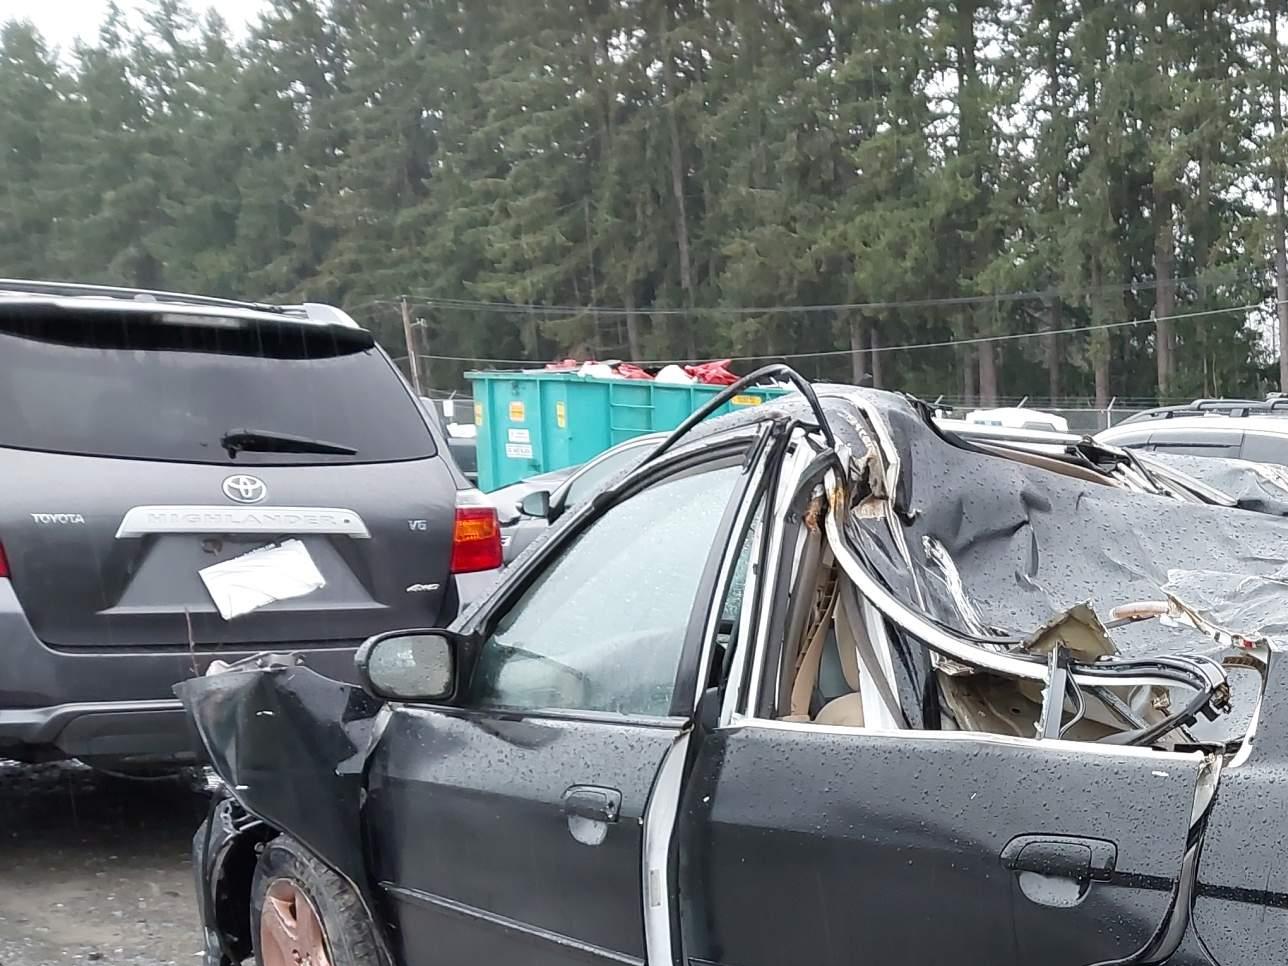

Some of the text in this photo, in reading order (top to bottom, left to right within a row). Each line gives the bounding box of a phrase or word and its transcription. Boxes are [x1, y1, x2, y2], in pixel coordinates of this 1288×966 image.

[30, 512, 86, 524] TOYOTA
[147, 512, 337, 527] HIGHLANDER
[407, 519, 428, 531] V6
